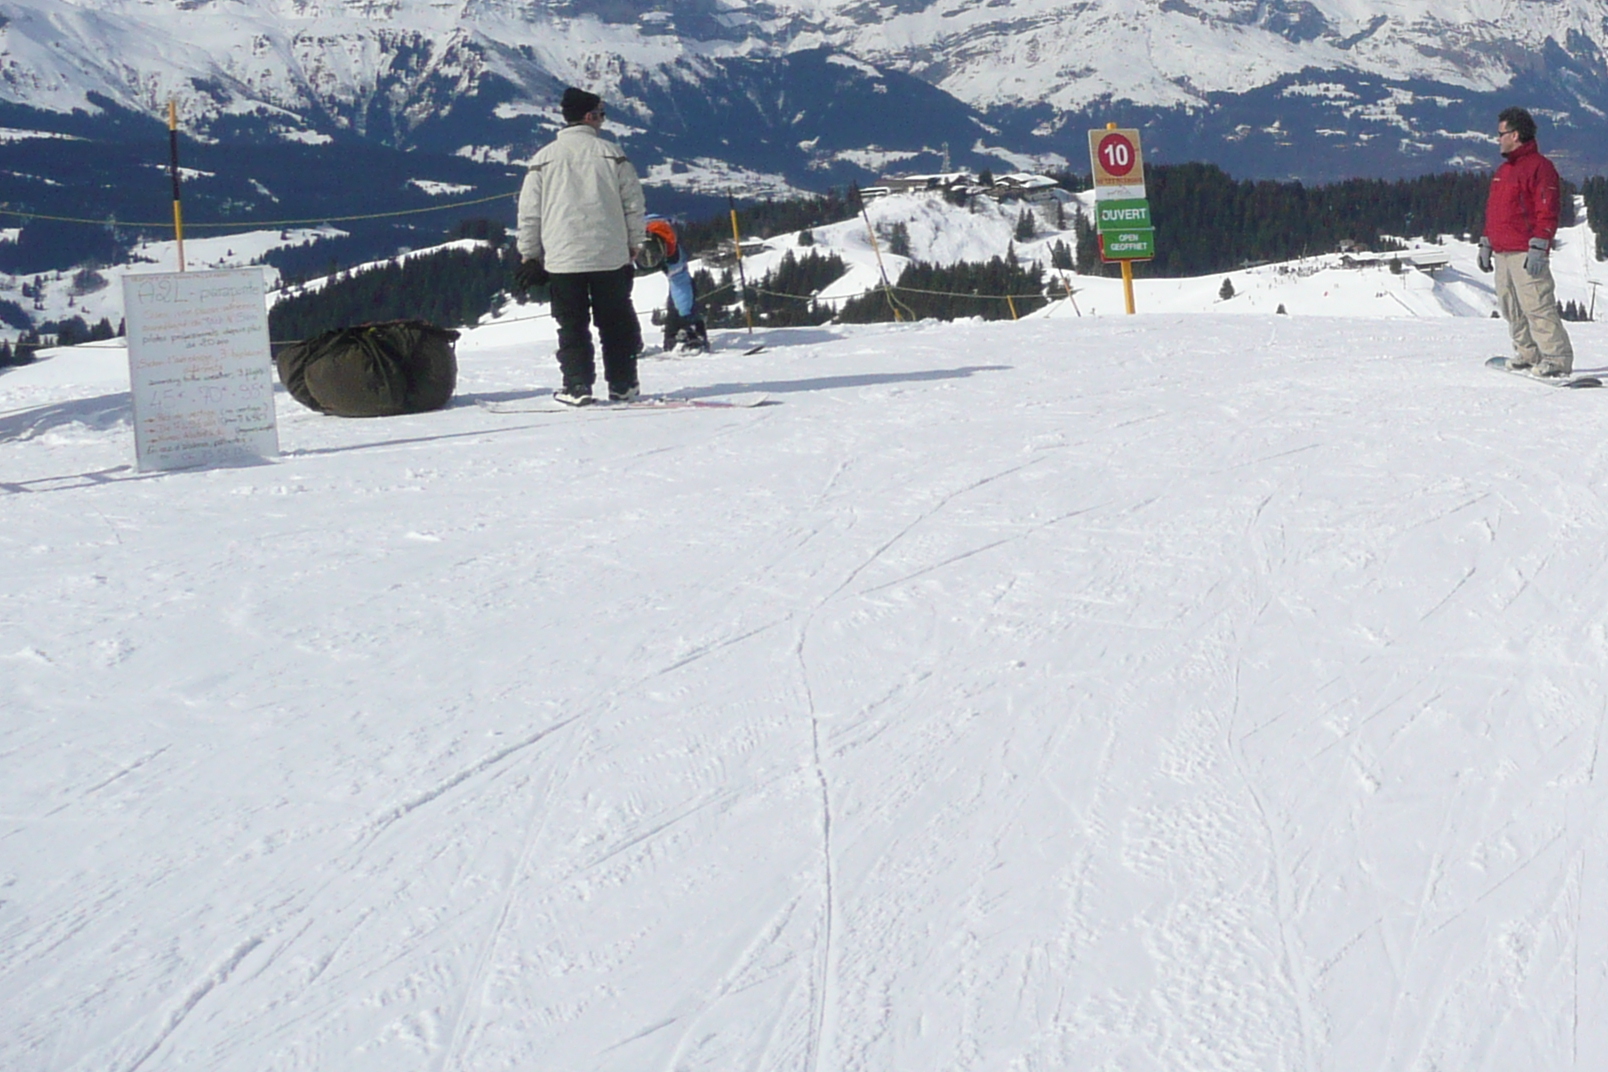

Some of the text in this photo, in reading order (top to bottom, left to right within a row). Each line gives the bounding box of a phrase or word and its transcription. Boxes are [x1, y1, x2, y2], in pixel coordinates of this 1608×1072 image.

[1104, 143, 1129, 166] 10
[1102, 208, 1147, 221] OUVERT
[1118, 233, 1139, 242] OPEN
[1110, 242, 1148, 251] GEOFFNET
